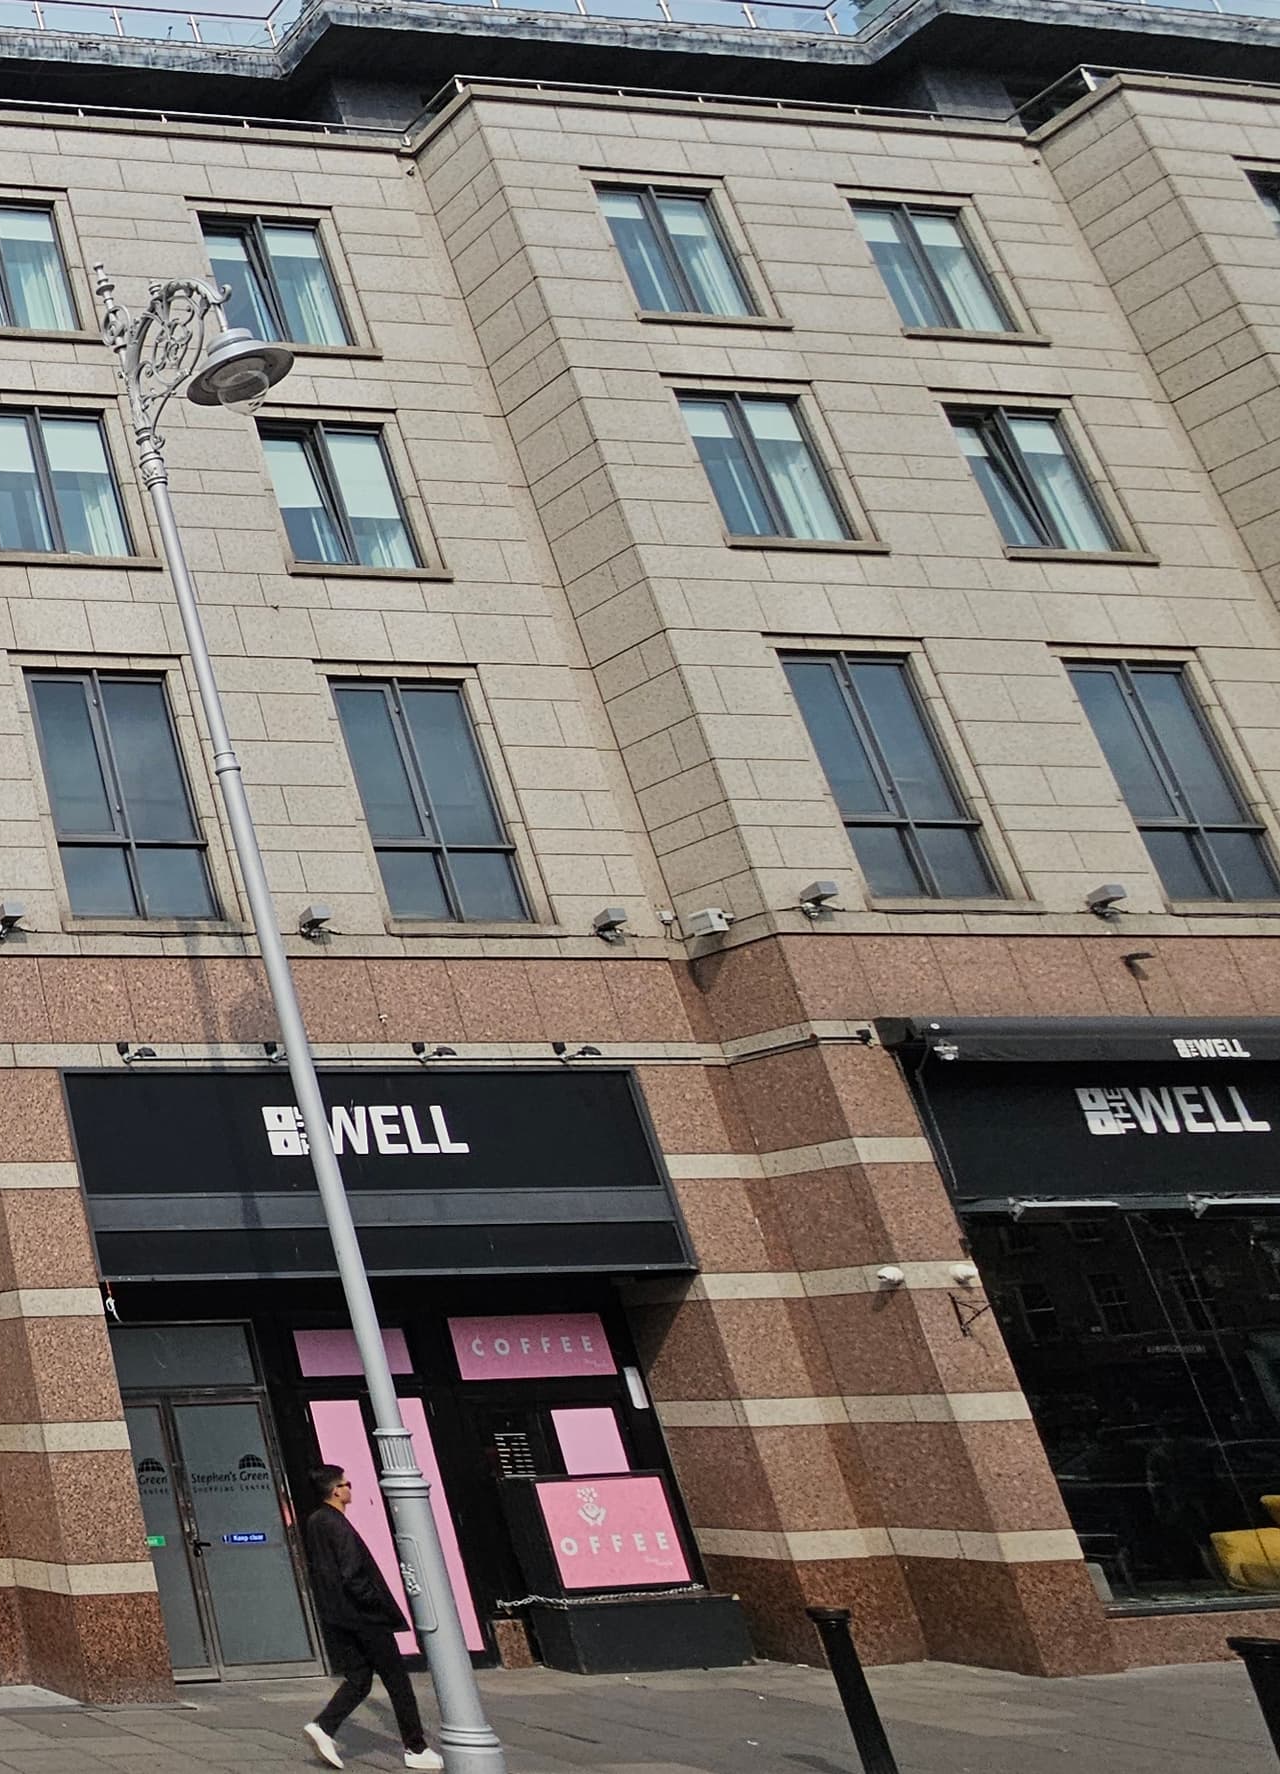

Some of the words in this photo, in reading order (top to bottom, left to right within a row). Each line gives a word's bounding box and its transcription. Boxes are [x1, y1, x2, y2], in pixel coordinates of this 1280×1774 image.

[1192, 1038, 1251, 1057] WELL
[1104, 1087, 1137, 1134] THE
[1120, 1086, 1271, 1134] WELL
[326, 1105, 470, 1155] WELL
[471, 1335, 594, 1357] COFFEE
[191, 1472, 237, 1485] Stephen's
[240, 1471, 269, 1482] Green
